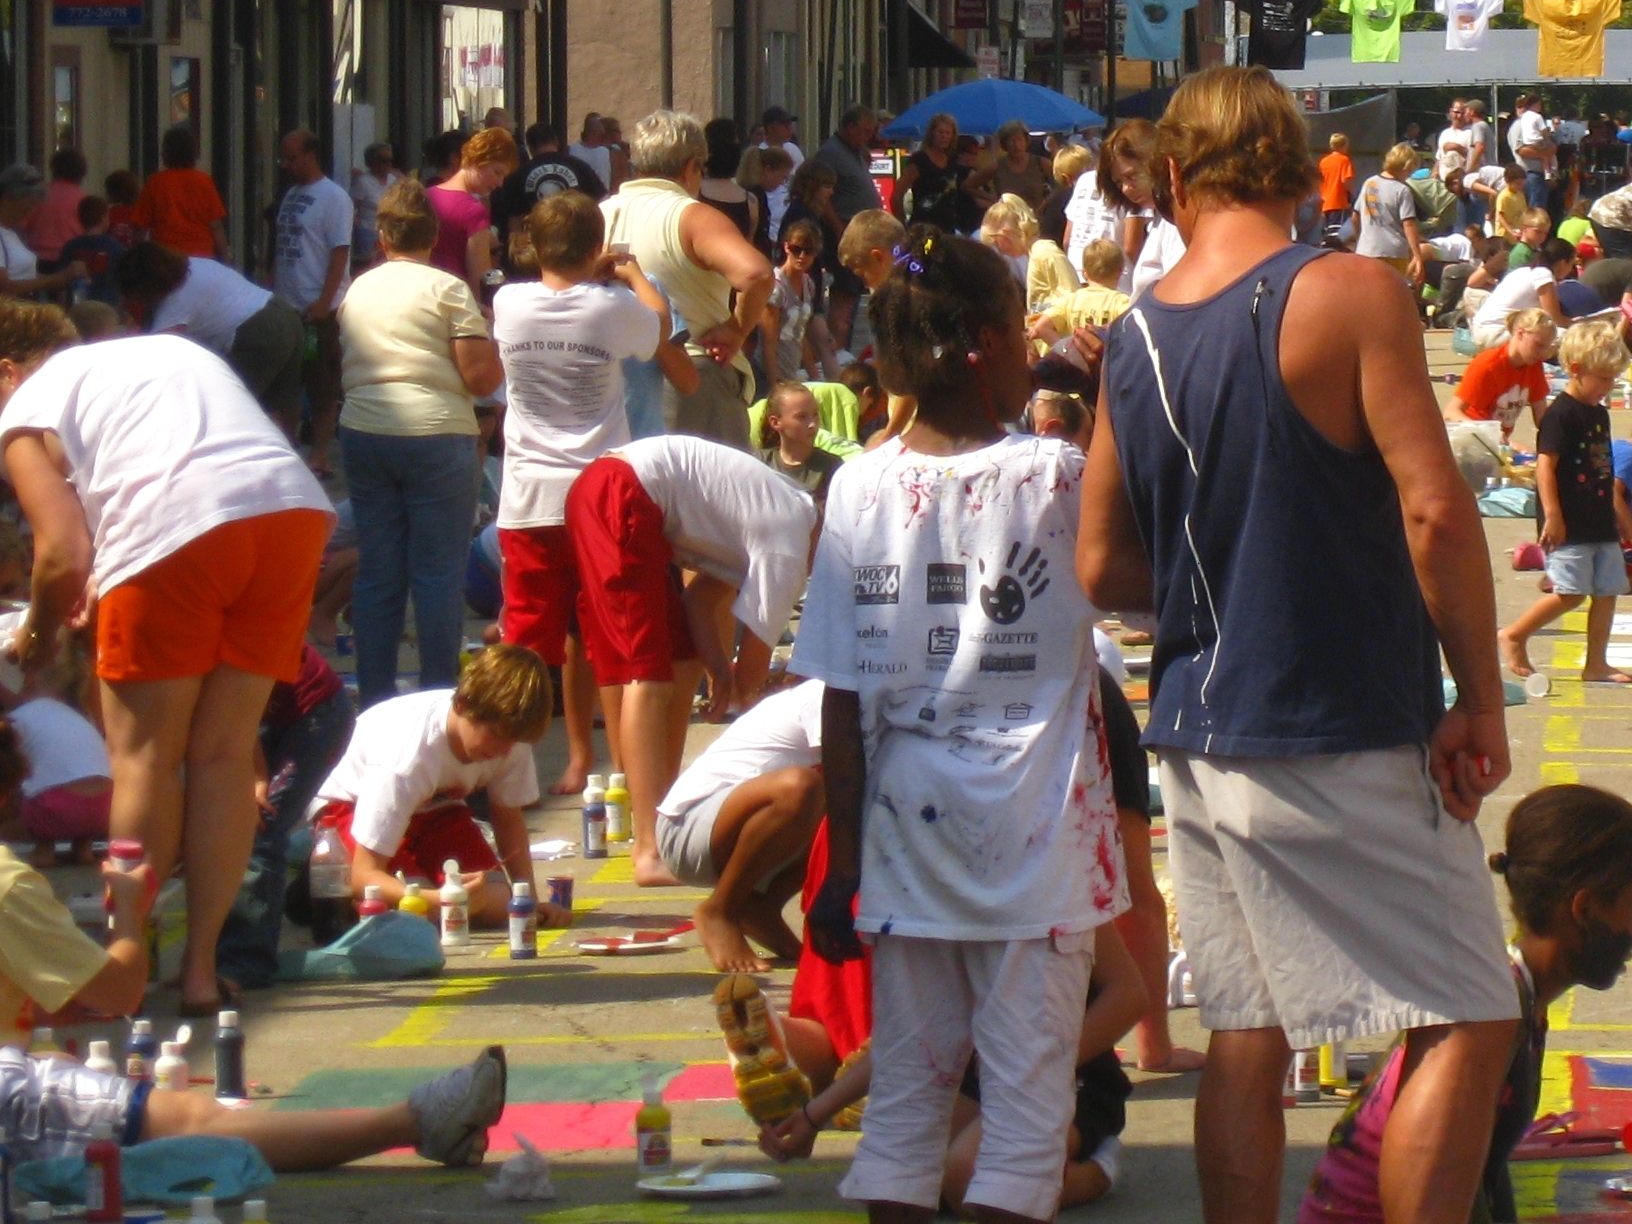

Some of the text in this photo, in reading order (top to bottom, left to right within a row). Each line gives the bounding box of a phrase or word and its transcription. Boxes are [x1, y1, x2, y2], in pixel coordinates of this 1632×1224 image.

[534, 341, 544, 350] TO
[547, 341, 565, 351] OUR
[885, 566, 898, 595] 6
[930, 575, 964, 585] WELLS
[985, 632, 1038, 644] GAZETTE
